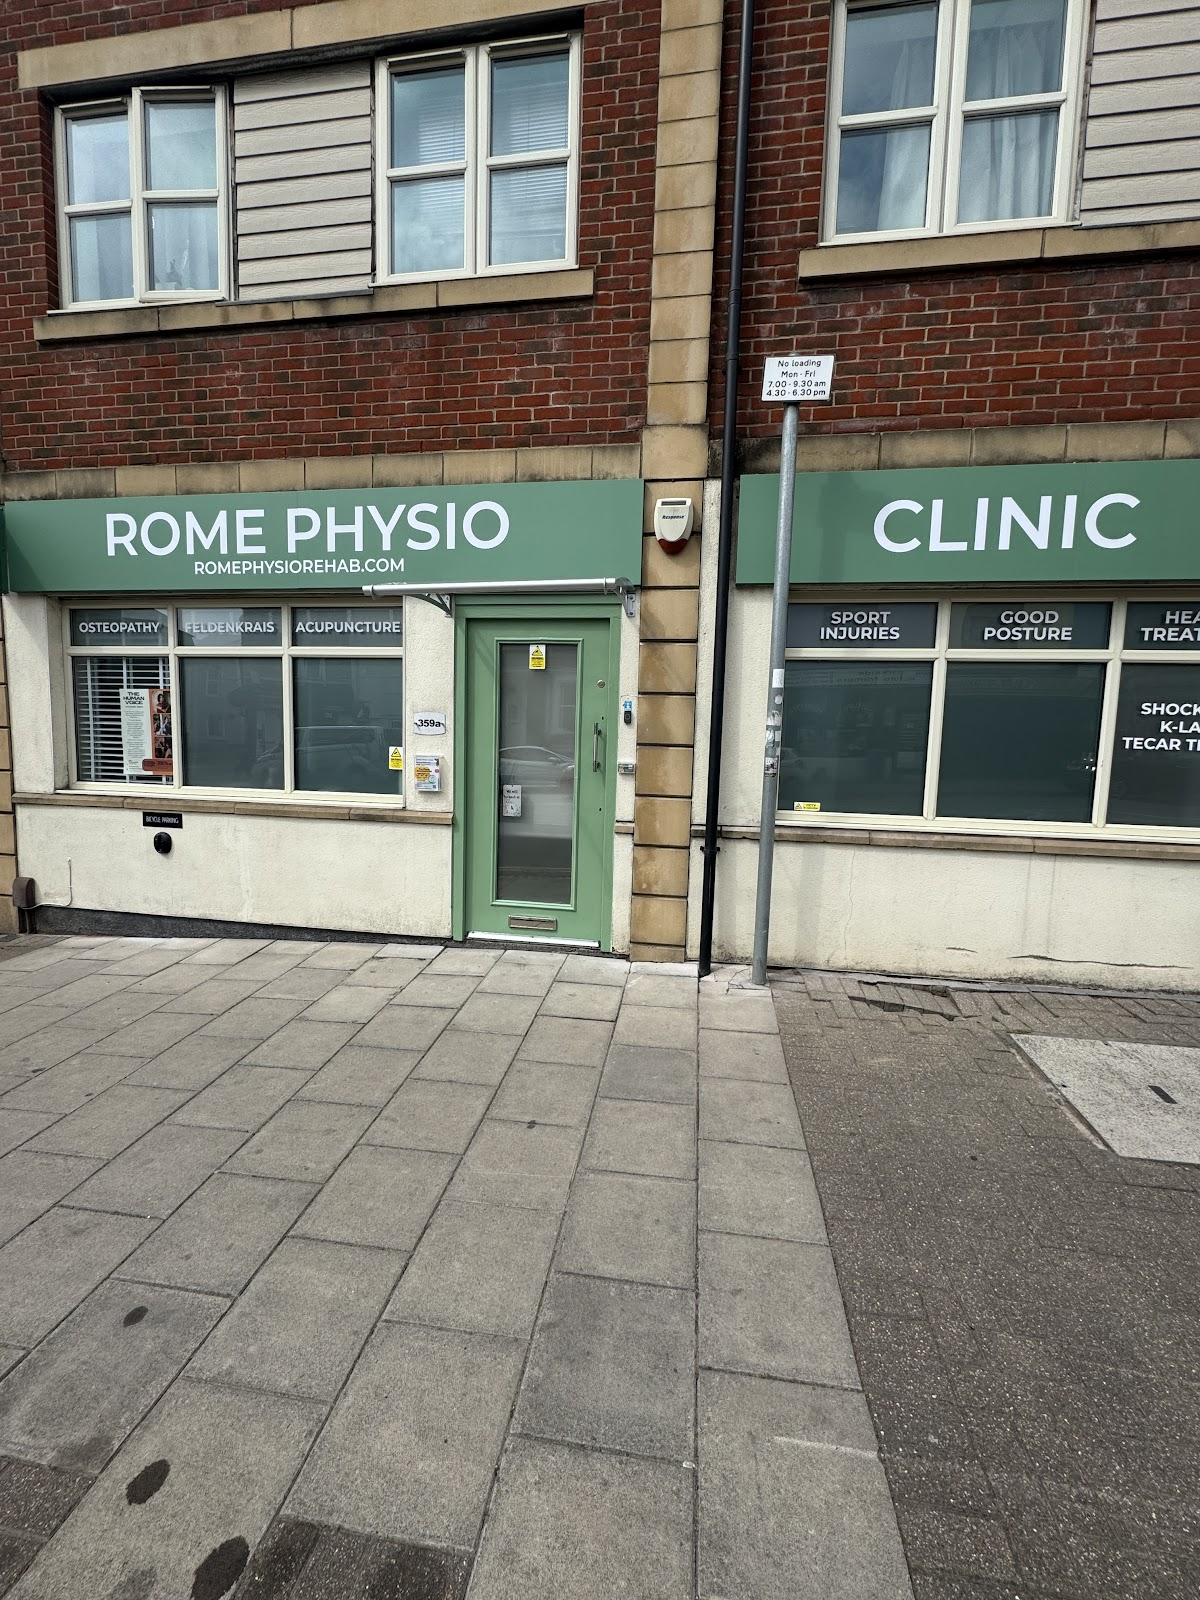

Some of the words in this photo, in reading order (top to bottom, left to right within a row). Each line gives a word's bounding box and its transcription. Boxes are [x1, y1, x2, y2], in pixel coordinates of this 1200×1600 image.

[792, 359, 822, 368] loading
[105, 509, 266, 556] ROME
[287, 500, 510, 553] PHYSIO
[873, 493, 1141, 553] CLINIC
[194, 558, 405, 575] ROMEPHYSIOREHAB.COM
[830, 611, 891, 624] SPORT
[1000, 610, 1059, 624] GOOD
[78, 621, 160, 634] OSTEOPATHY
[185, 621, 274, 633] FELDENKRAIS
[295, 621, 401, 633] ACUPUNCTURE
[820, 626, 900, 640] INJURIES
[983, 627, 1072, 641] POSTURE
[418, 719, 441, 728] 359a
[1122, 737, 1181, 751] TECAR
